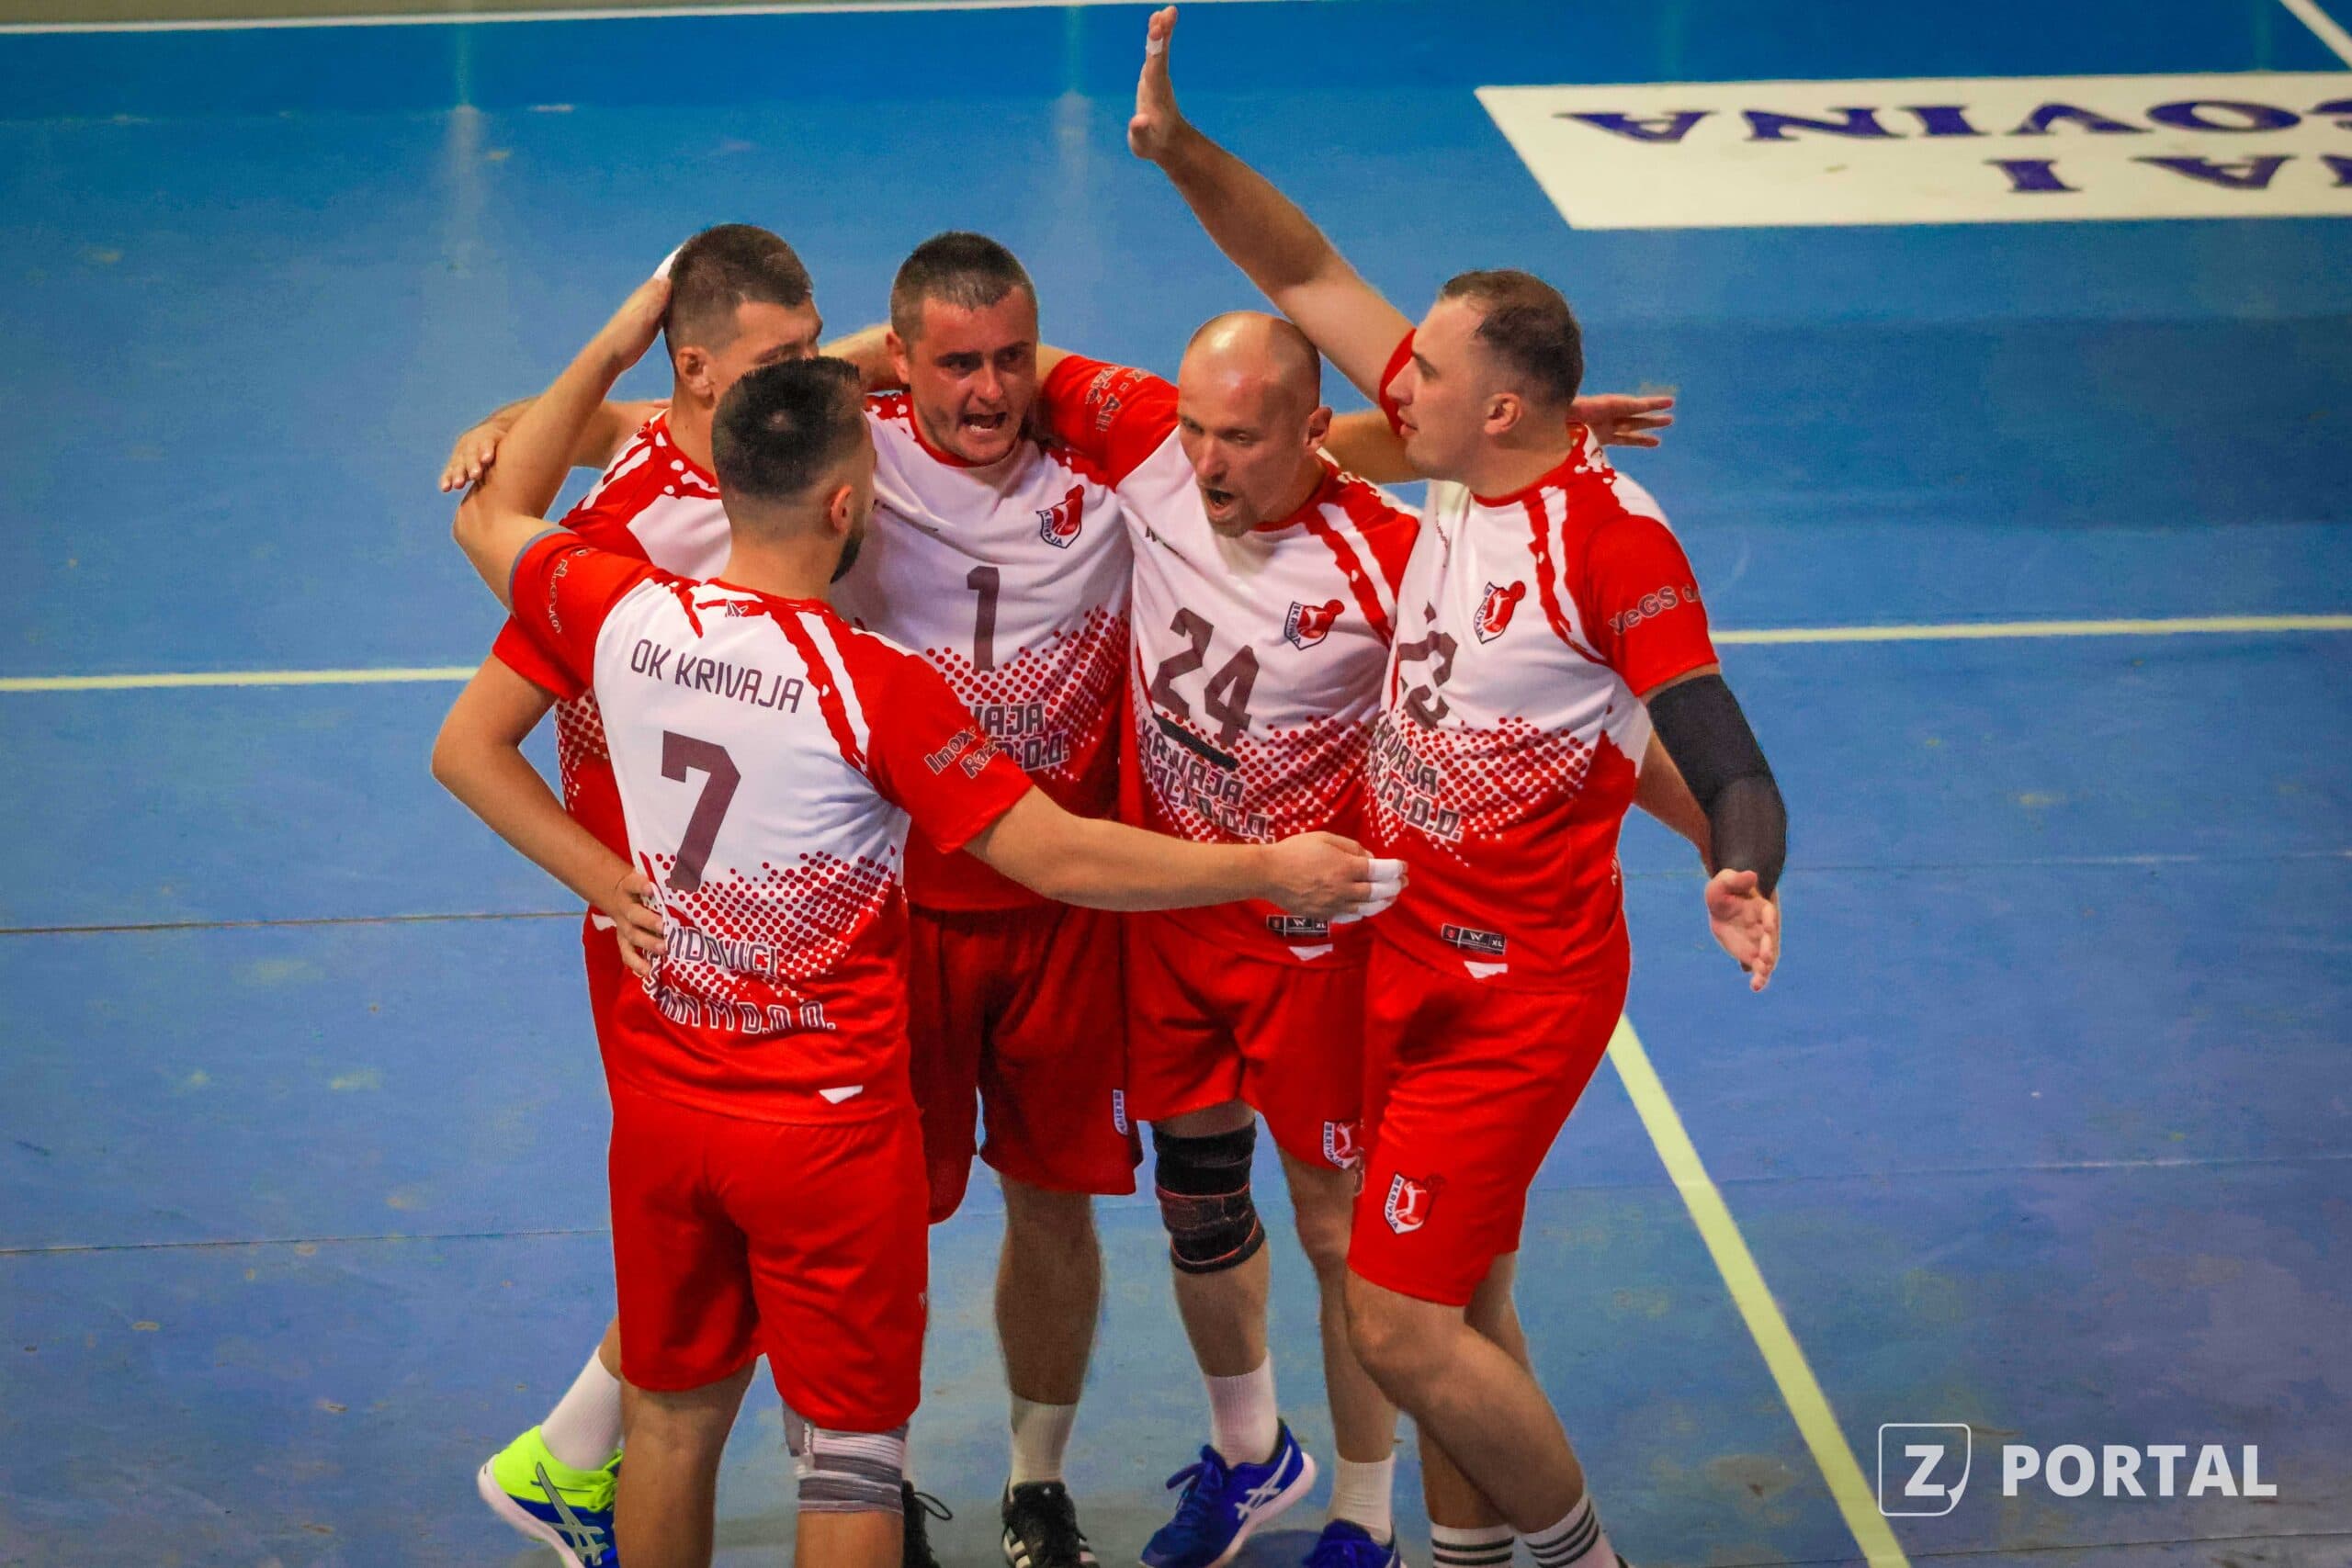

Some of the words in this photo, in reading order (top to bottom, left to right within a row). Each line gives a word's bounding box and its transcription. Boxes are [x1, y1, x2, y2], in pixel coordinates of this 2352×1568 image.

[967, 565, 1000, 672] 1
[630, 638, 672, 681] OK
[674, 652, 805, 714] KRIVAJA
[1149, 606, 1260, 747] 24
[659, 729, 741, 894] 7
[1386, 1187, 1399, 1229] KRIVAJA
